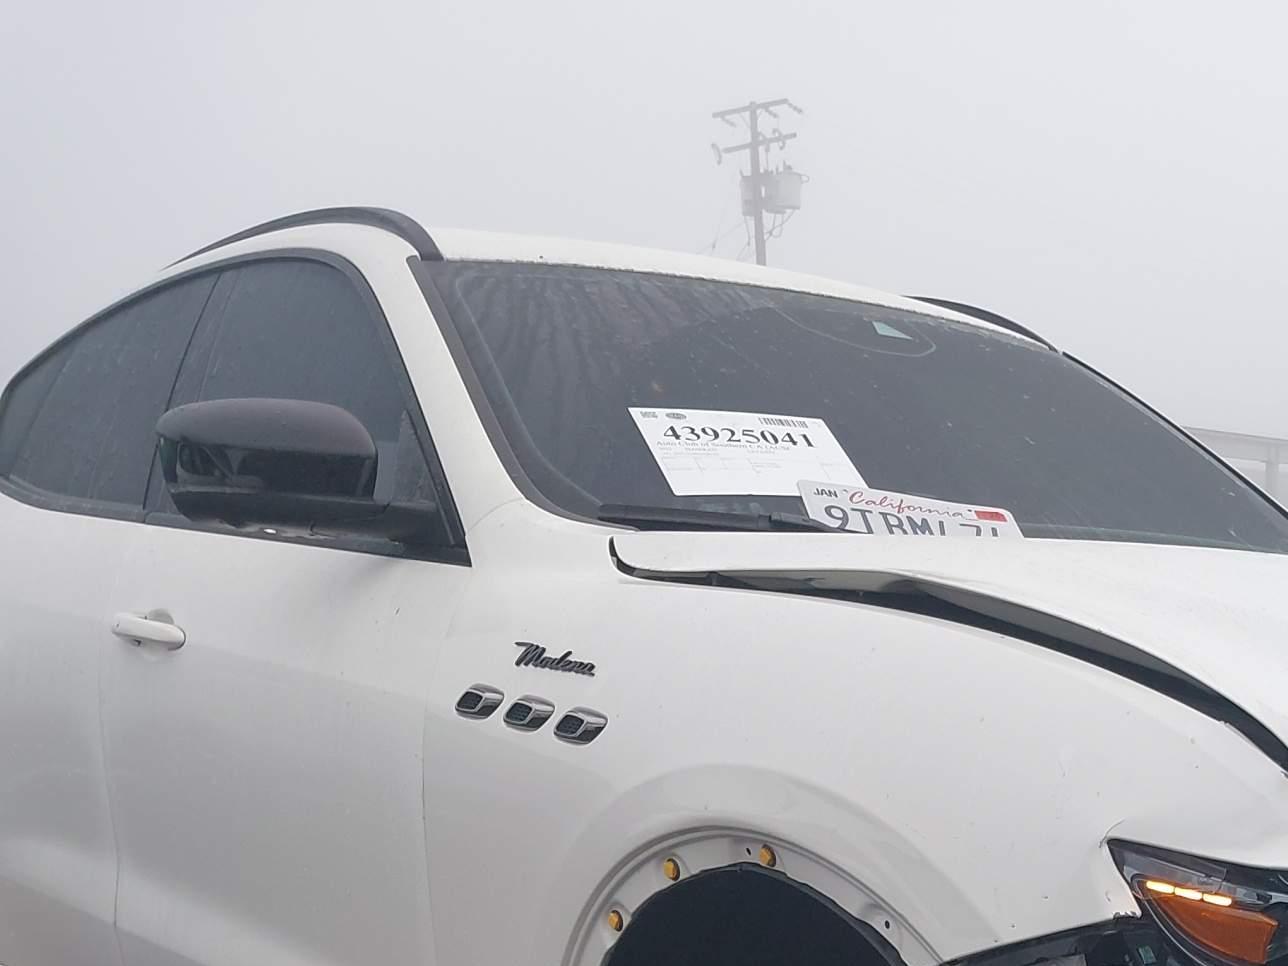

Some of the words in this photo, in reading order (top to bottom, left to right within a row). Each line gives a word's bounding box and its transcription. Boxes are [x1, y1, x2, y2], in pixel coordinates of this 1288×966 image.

[663, 425, 816, 448] 43925041
[813, 488, 838, 498] JAN
[849, 490, 963, 518] California
[514, 641, 596, 677] Modena
